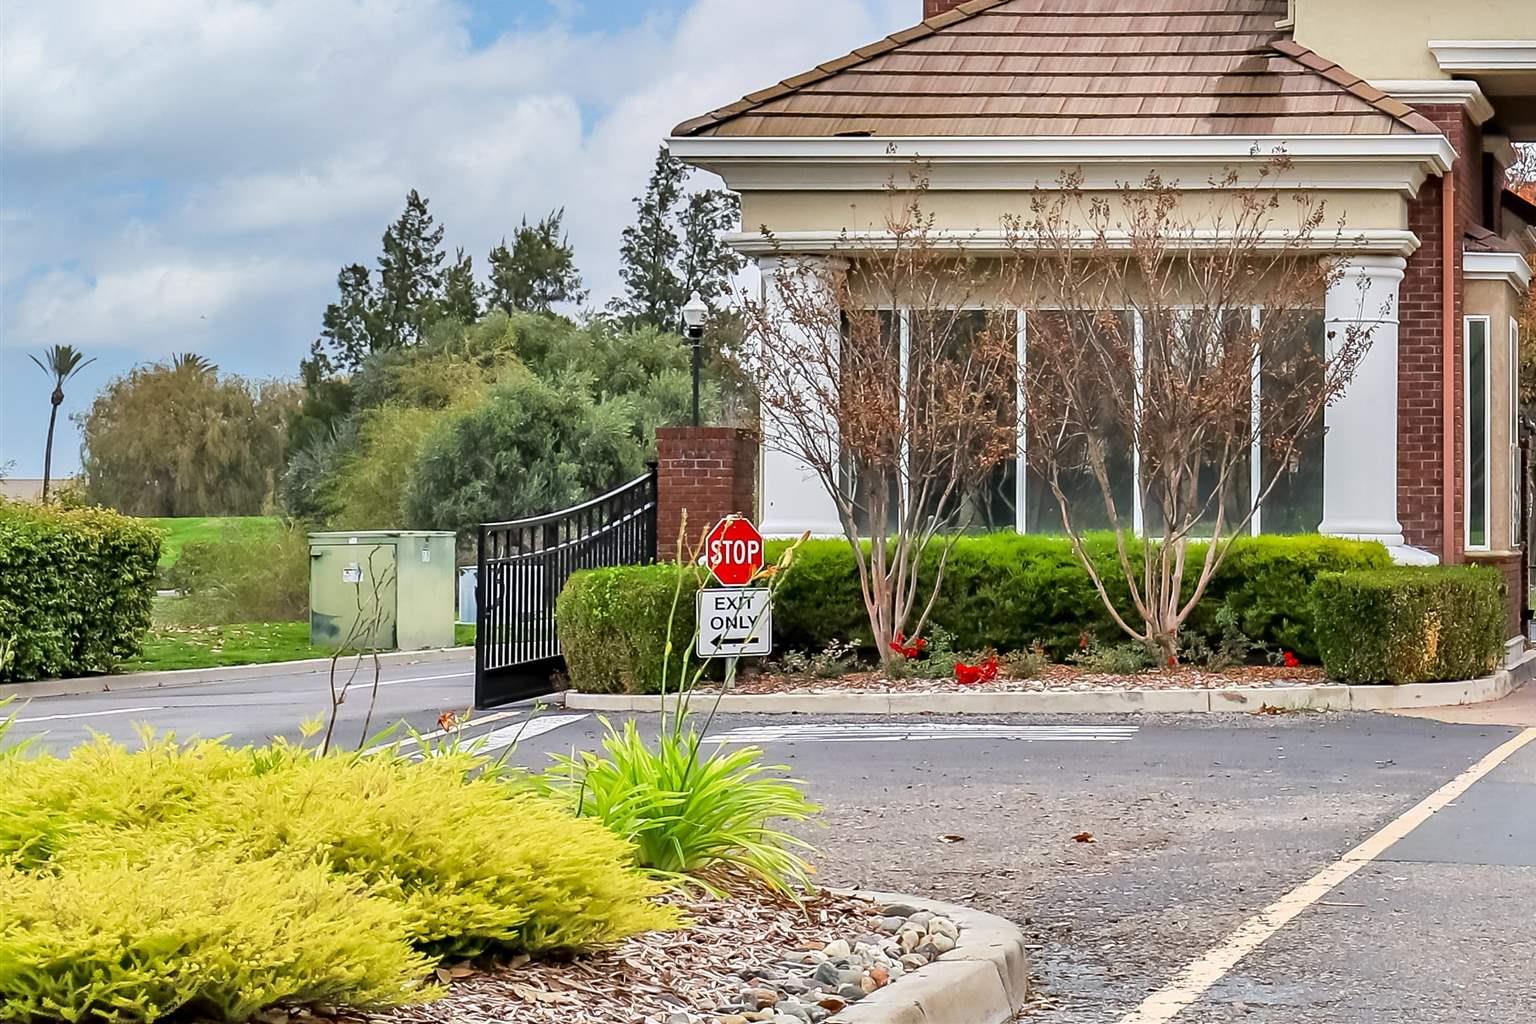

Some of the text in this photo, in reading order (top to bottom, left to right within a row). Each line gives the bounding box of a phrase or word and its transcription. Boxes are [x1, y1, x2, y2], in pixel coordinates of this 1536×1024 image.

[710, 540, 760, 565] STOP
[714, 596, 755, 611] EXIT
[710, 615, 758, 630] ONLY
